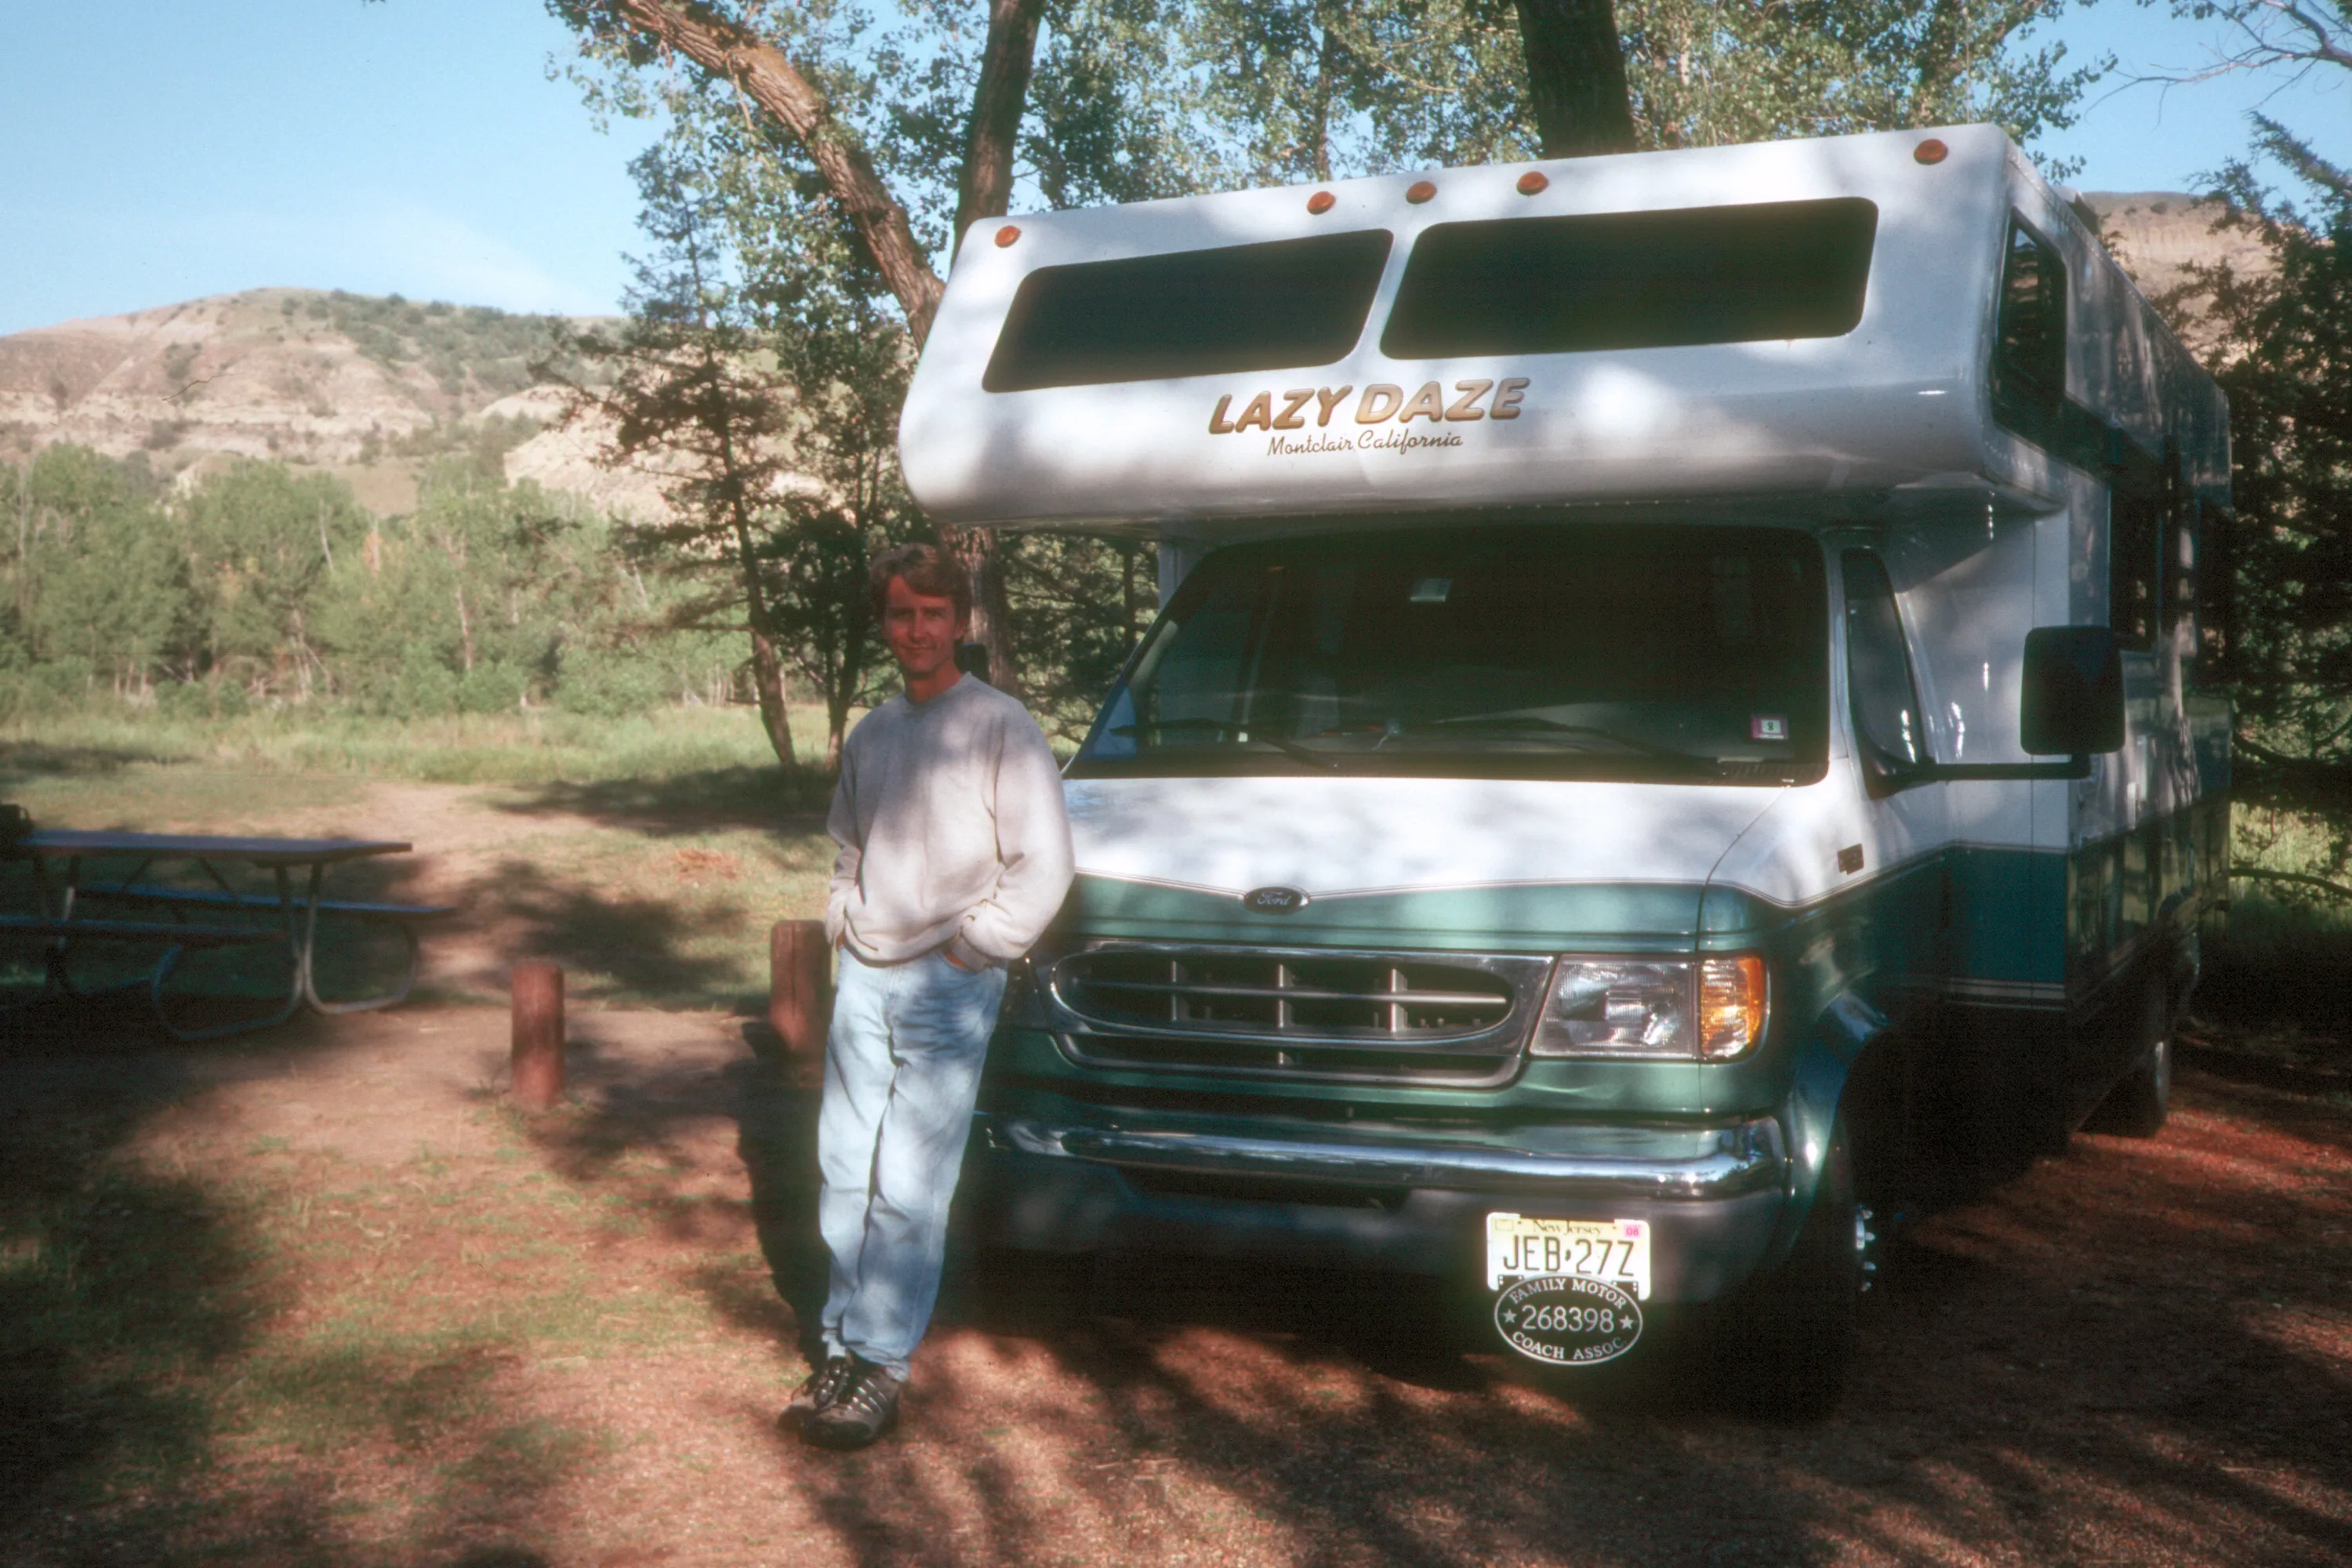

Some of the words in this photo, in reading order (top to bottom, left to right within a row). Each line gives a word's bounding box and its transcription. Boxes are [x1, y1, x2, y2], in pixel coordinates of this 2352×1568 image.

[1208, 385, 1353, 434] LAZY
[1355, 377, 1530, 423] DAZE
[1357, 428, 1463, 455] California
[1257, 891, 1292, 906] Ford
[1533, 1219, 1563, 1232] New
[1626, 1227, 1639, 1236] 08
[1509, 1278, 1566, 1305] FAMILY
[1572, 1278, 1627, 1310] MOTOR
[1522, 1305, 1615, 1334] 268398
[1512, 1331, 1565, 1360] COACH
